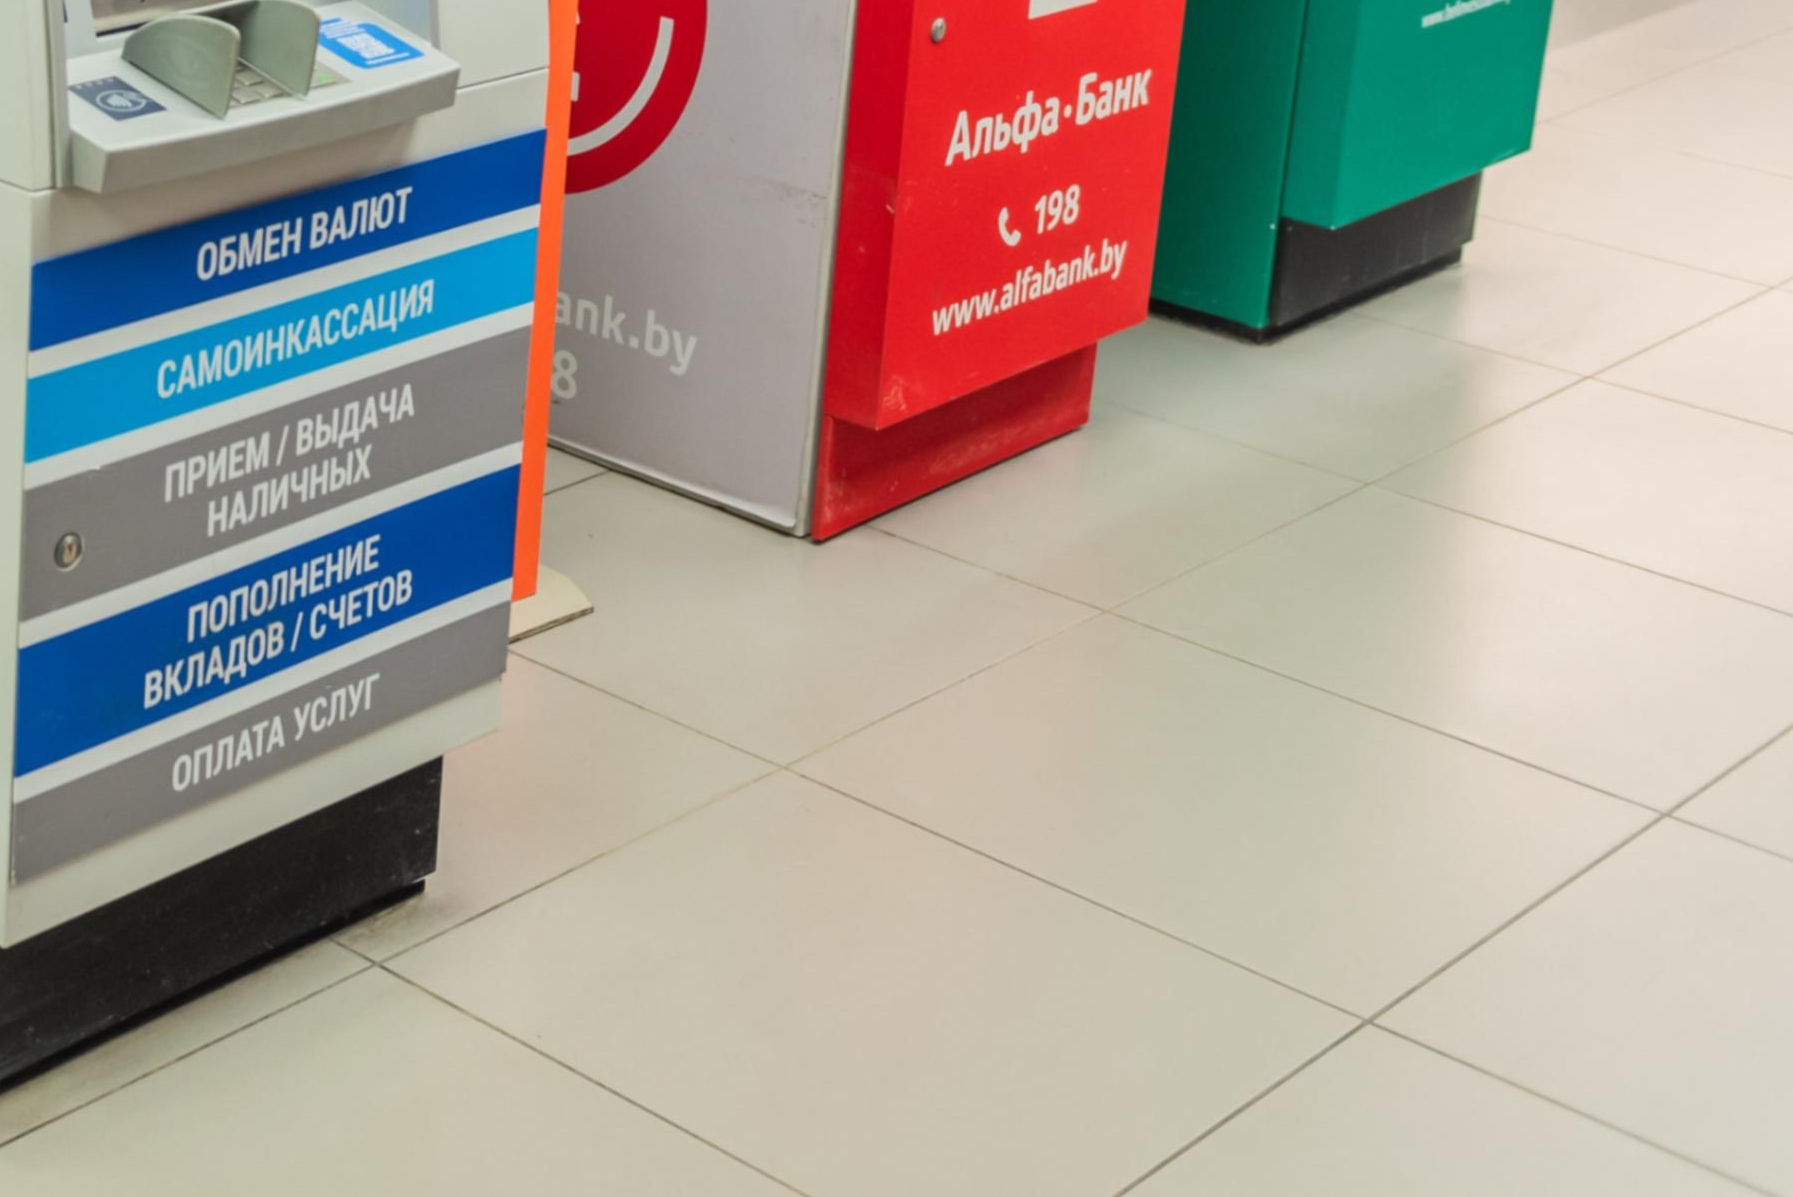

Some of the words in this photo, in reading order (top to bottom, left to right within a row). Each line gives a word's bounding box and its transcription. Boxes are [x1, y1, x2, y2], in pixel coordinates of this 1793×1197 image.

[196, 216, 302, 282] ОБМЕН
[308, 186, 413, 251] ВАЛЮТ
[1034, 183, 1081, 237] 198
[156, 278, 435, 400] САМОИНКАССАЦИЯ
[931, 238, 1129, 338] www.alfabank.by
[164, 431, 270, 503] ПРИЕМ
[295, 383, 416, 458] ВЫДАЧА
[207, 444, 373, 538] НАЛИЧНЫХ
[143, 625, 285, 710] ВКЛАДОВ
[309, 569, 414, 642] СЧЕТОВ
[186, 534, 381, 644] ПОПОЛНЕНИЕ
[171, 715, 286, 792] ОПЛАТА
[294, 672, 381, 742] УСЛУГ
